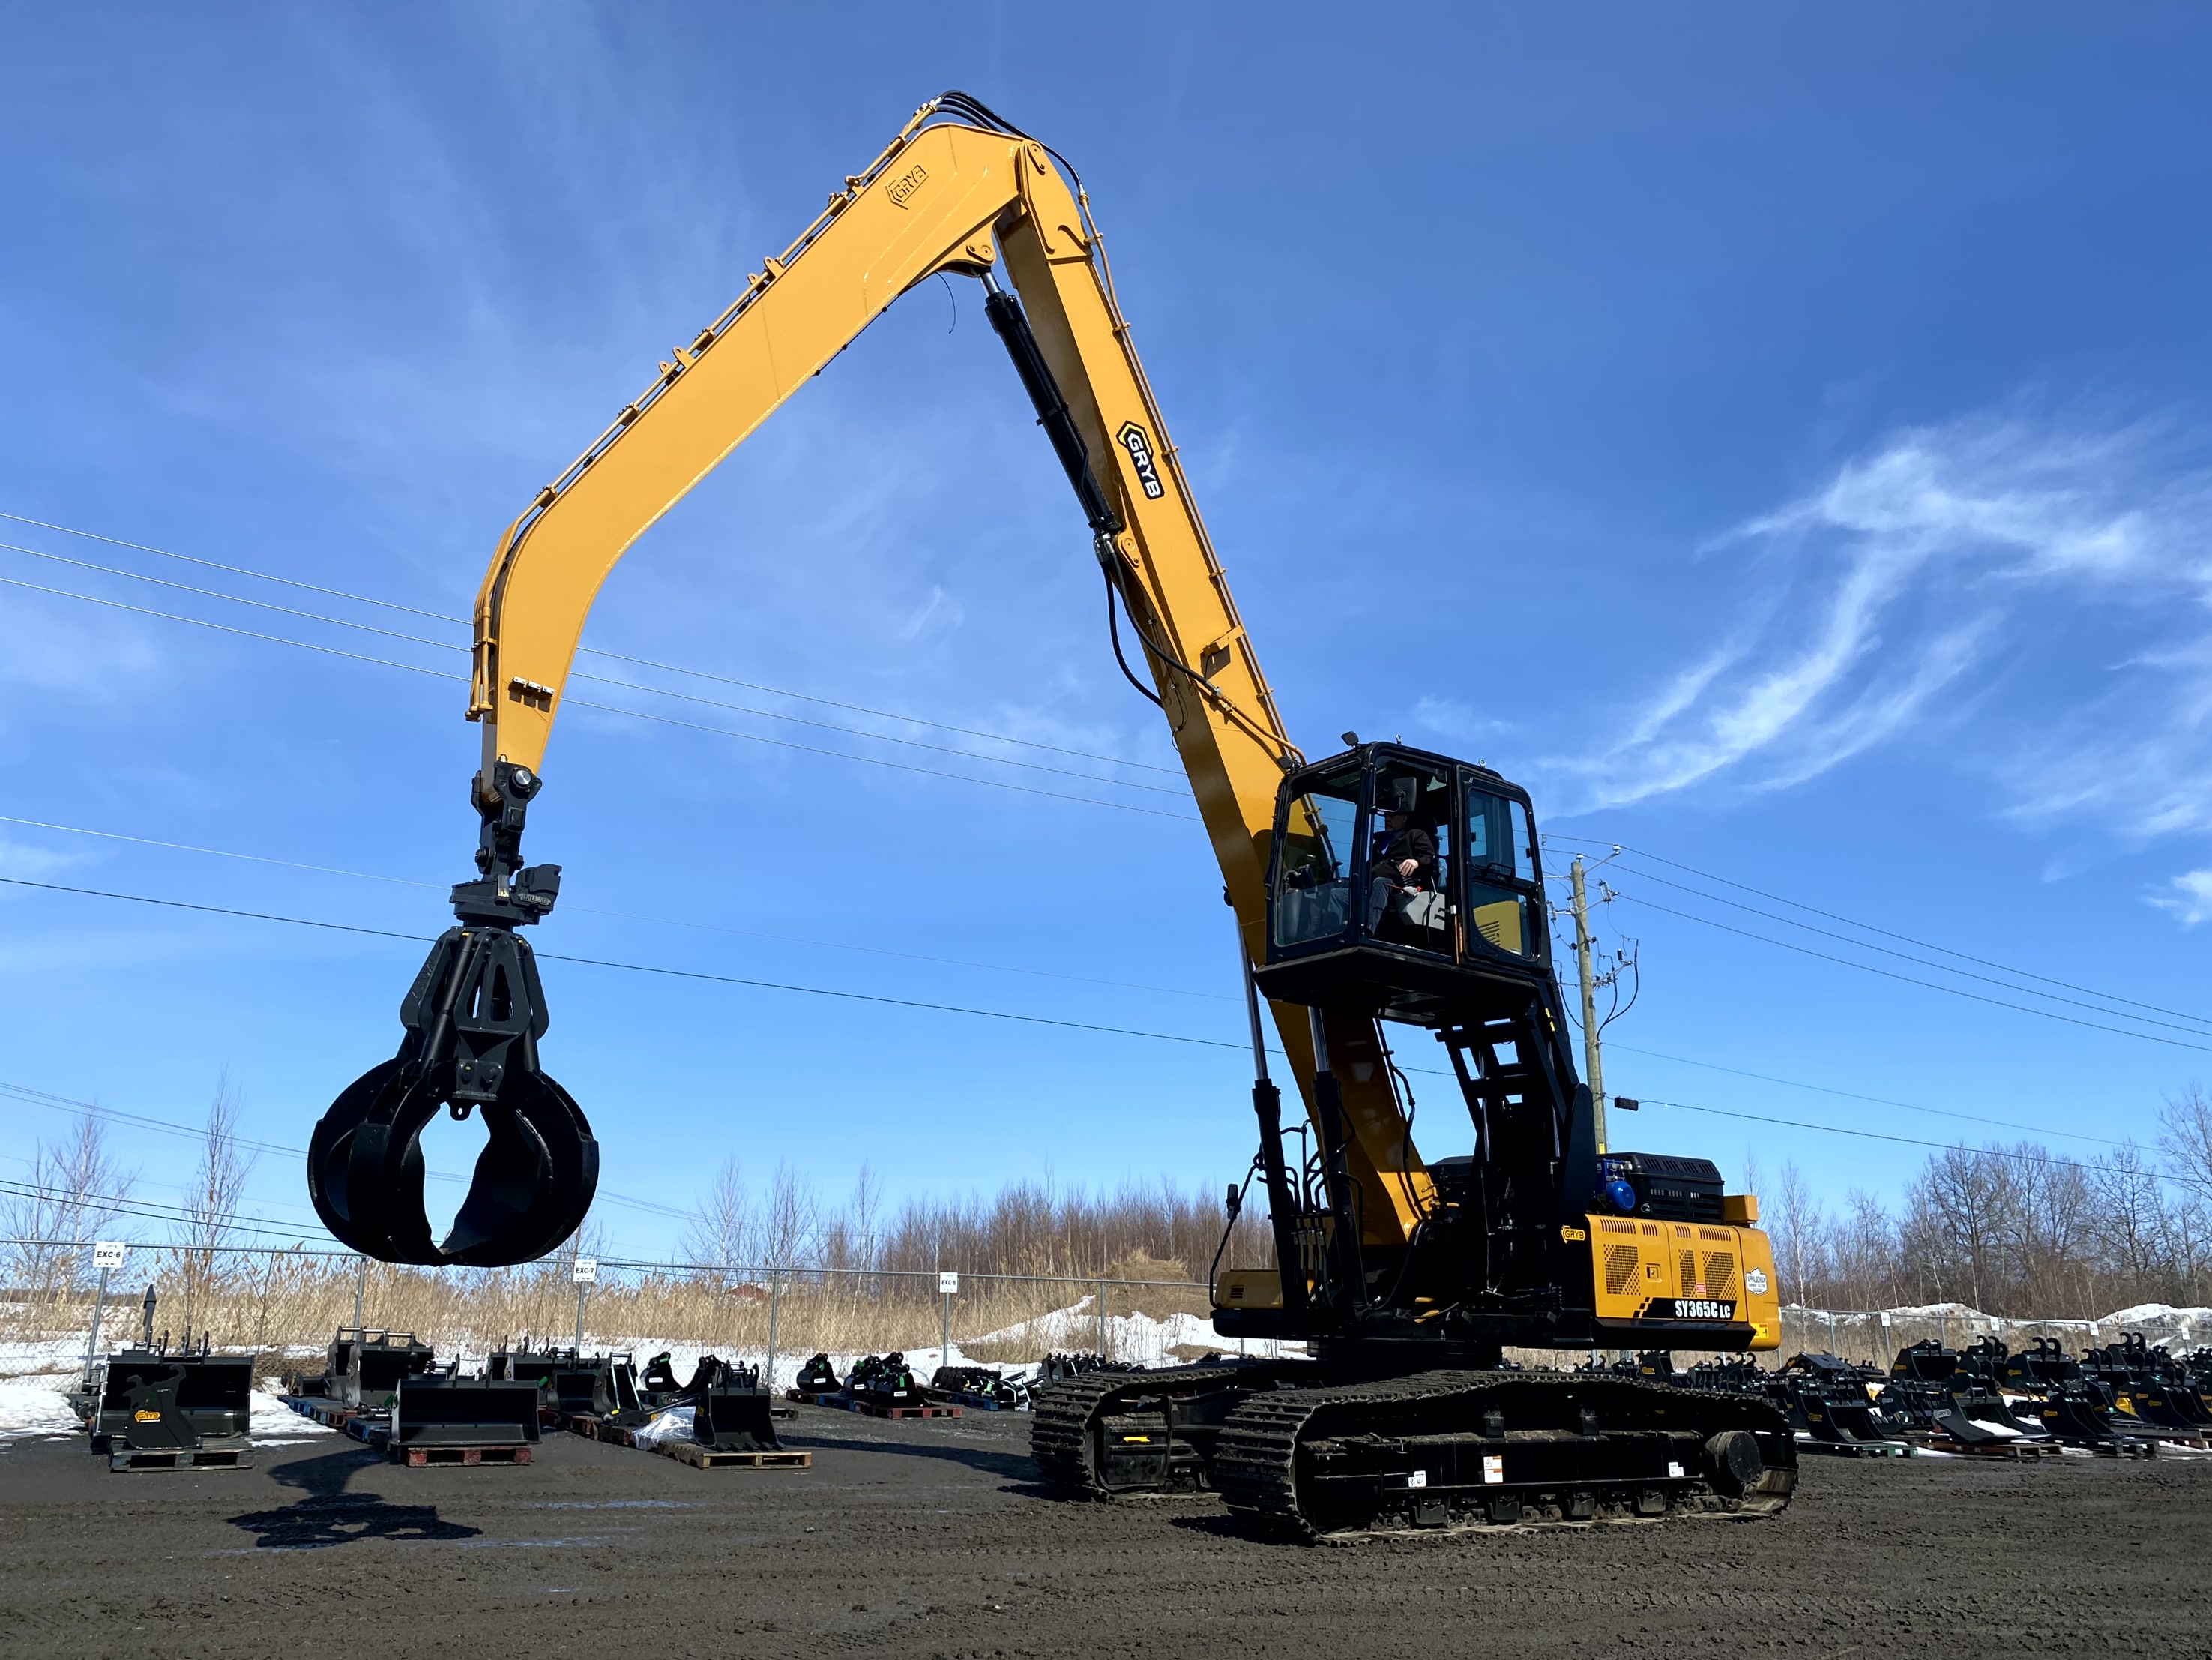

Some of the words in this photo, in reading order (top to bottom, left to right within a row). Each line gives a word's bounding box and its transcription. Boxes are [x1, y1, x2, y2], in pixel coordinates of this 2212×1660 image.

[893, 164, 926, 199] GRYB
[1127, 433, 1161, 497] GRYB
[1565, 1230, 1585, 1239] GRYB
[1675, 1299, 1718, 1318] SY365C
[1719, 1305, 1731, 1318] LC
